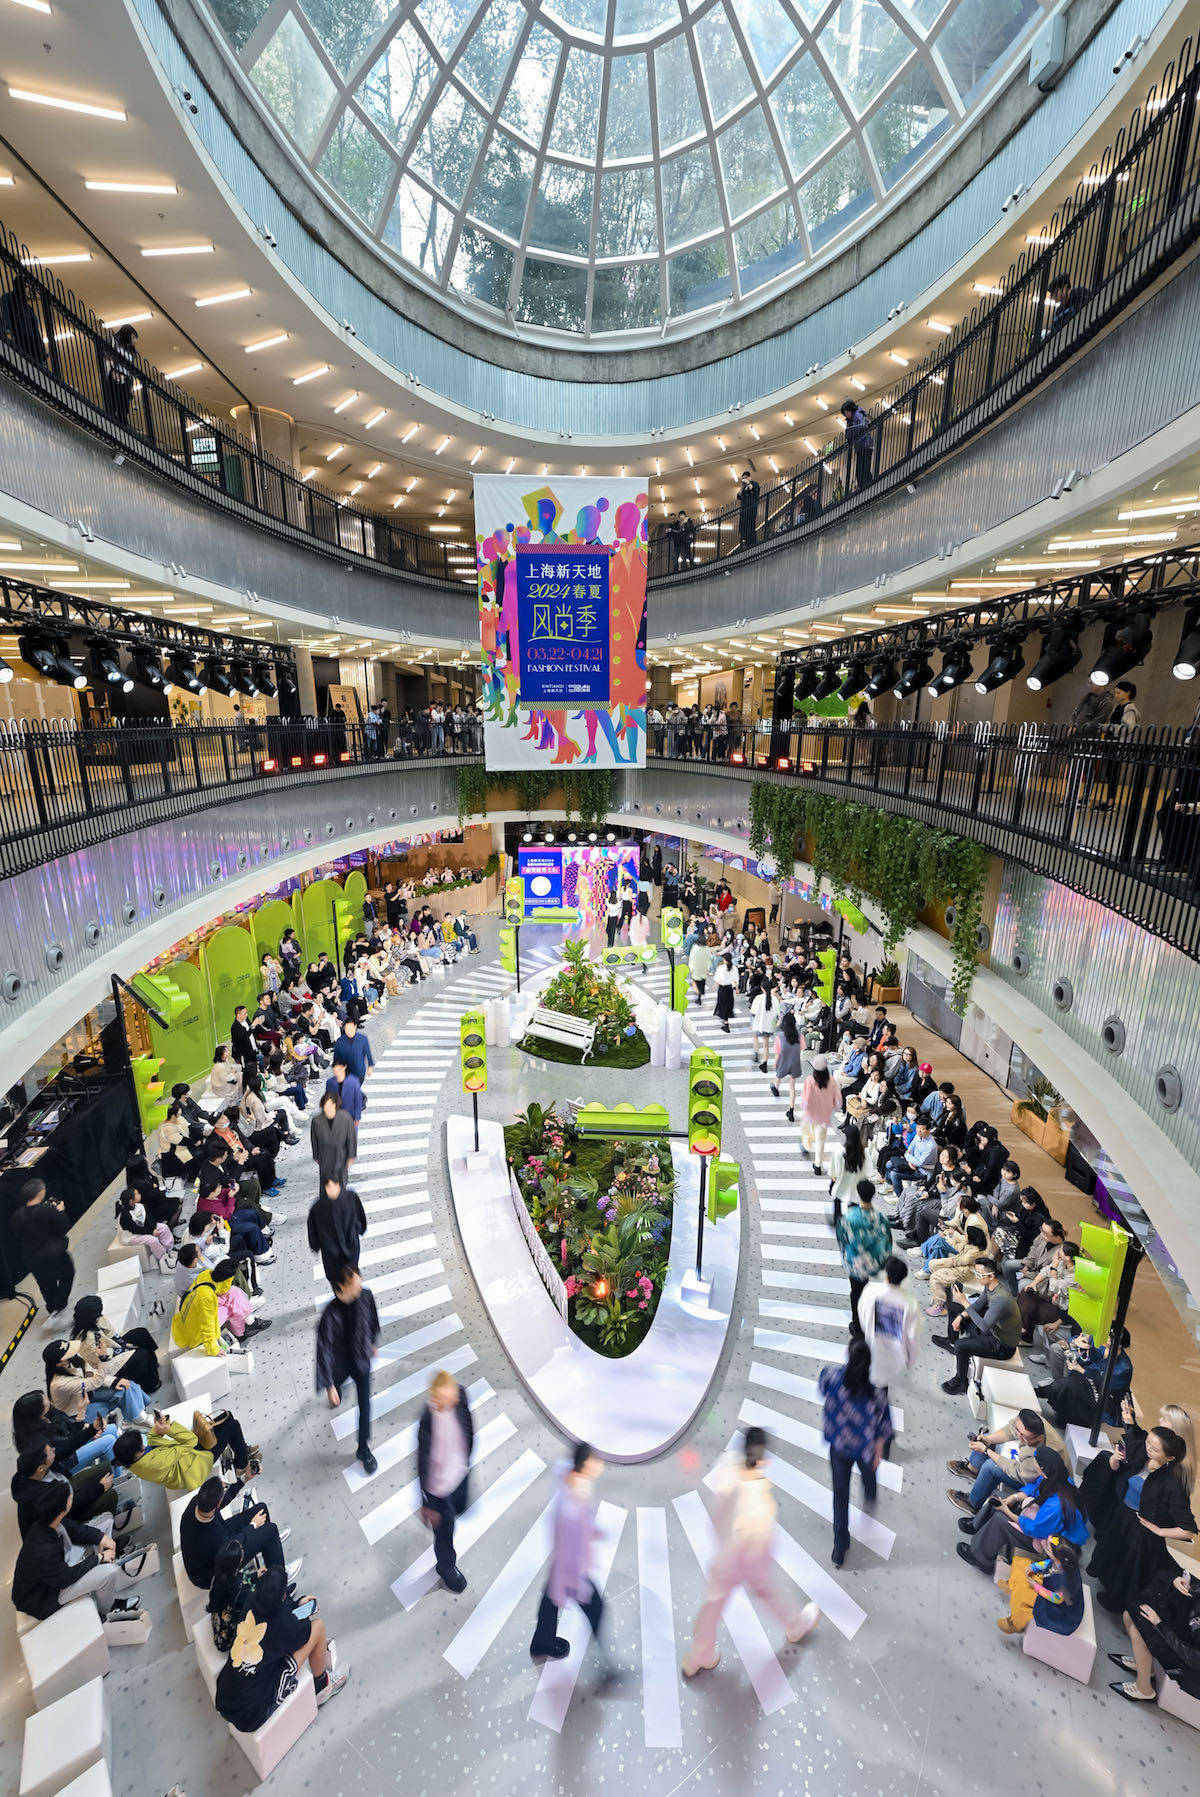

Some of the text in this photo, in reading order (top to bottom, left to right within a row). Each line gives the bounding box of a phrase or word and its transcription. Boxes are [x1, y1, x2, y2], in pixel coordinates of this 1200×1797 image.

[525, 563, 602, 579] 上海新天地
[533, 603, 597, 637] 风尚季
[527, 647, 603, 660] 03.22-04.21
[527, 664, 602, 672] FASHION FESTIVAL
